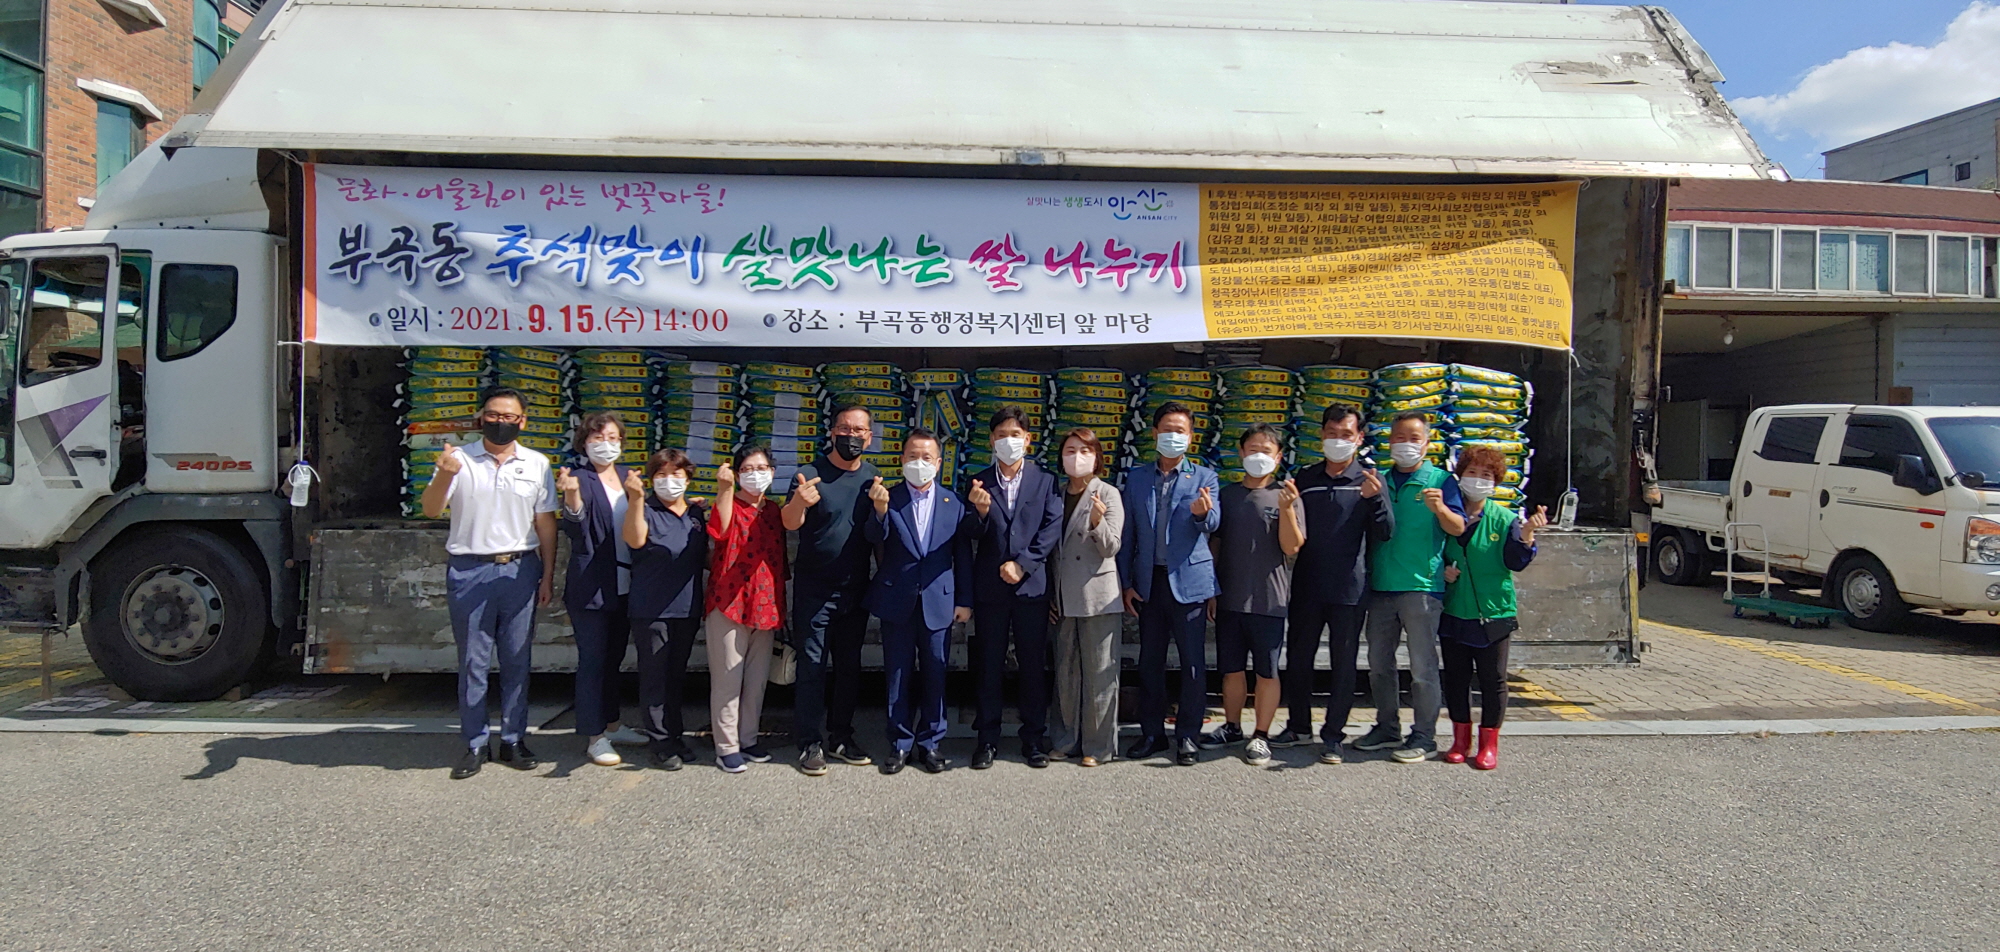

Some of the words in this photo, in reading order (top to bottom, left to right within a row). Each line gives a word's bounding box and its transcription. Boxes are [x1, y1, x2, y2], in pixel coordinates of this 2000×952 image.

[539, 181, 588, 210] 있는
[601, 179, 728, 215] 벚꽃마을!
[1063, 196, 1103, 208] 생생도시
[1217, 189, 1237, 200] 후원
[1461, 191, 1491, 201] 위원장
[1494, 191, 1503, 200] 외
[1507, 190, 1527, 200] 위원
[1303, 202, 1324, 212] 회장
[1329, 202, 1339, 211] 외
[1344, 202, 1365, 212] 회원
[1208, 211, 1240, 221] 위원장
[1245, 212, 1255, 221] 외
[1261, 212, 1282, 222] 위원
[1446, 214, 1467, 222] 회장
[1512, 208, 1531, 218] 회장
[1536, 209, 1547, 217] 외
[1209, 222, 1231, 232] 회원
[1392, 224, 1425, 233] 위원장
[1501, 219, 1534, 228] 체육회
[1207, 234, 1243, 245] (김유경
[1248, 235, 1269, 245] 회장
[1274, 235, 1284, 245] 외
[1287, 236, 1309, 245] 회원
[1444, 230, 1465, 240] 대장
[1468, 230, 1478, 239] 외
[1481, 230, 1502, 239] 대원
[328, 221, 470, 283] 부곡동
[486, 223, 703, 284] 추석맞이
[721, 224, 951, 288] 살맛나는
[968, 232, 1028, 290] 쌀
[1043, 237, 1184, 290] 나누기
[1321, 295, 1344, 303] 회장
[1365, 291, 1387, 299] 회원
[387, 307, 429, 332] 일시
[653, 308, 729, 332] 14:00
[782, 309, 829, 333] 장소
[855, 310, 1067, 336] 부곡동행정복지센터
[1075, 312, 1097, 336] 앞
[1104, 312, 1152, 336] 마당
[1313, 320, 1387, 330] 한국수자원공사
[1547, 331, 1561, 341] 대표
[176, 460, 252, 472] 240PS
